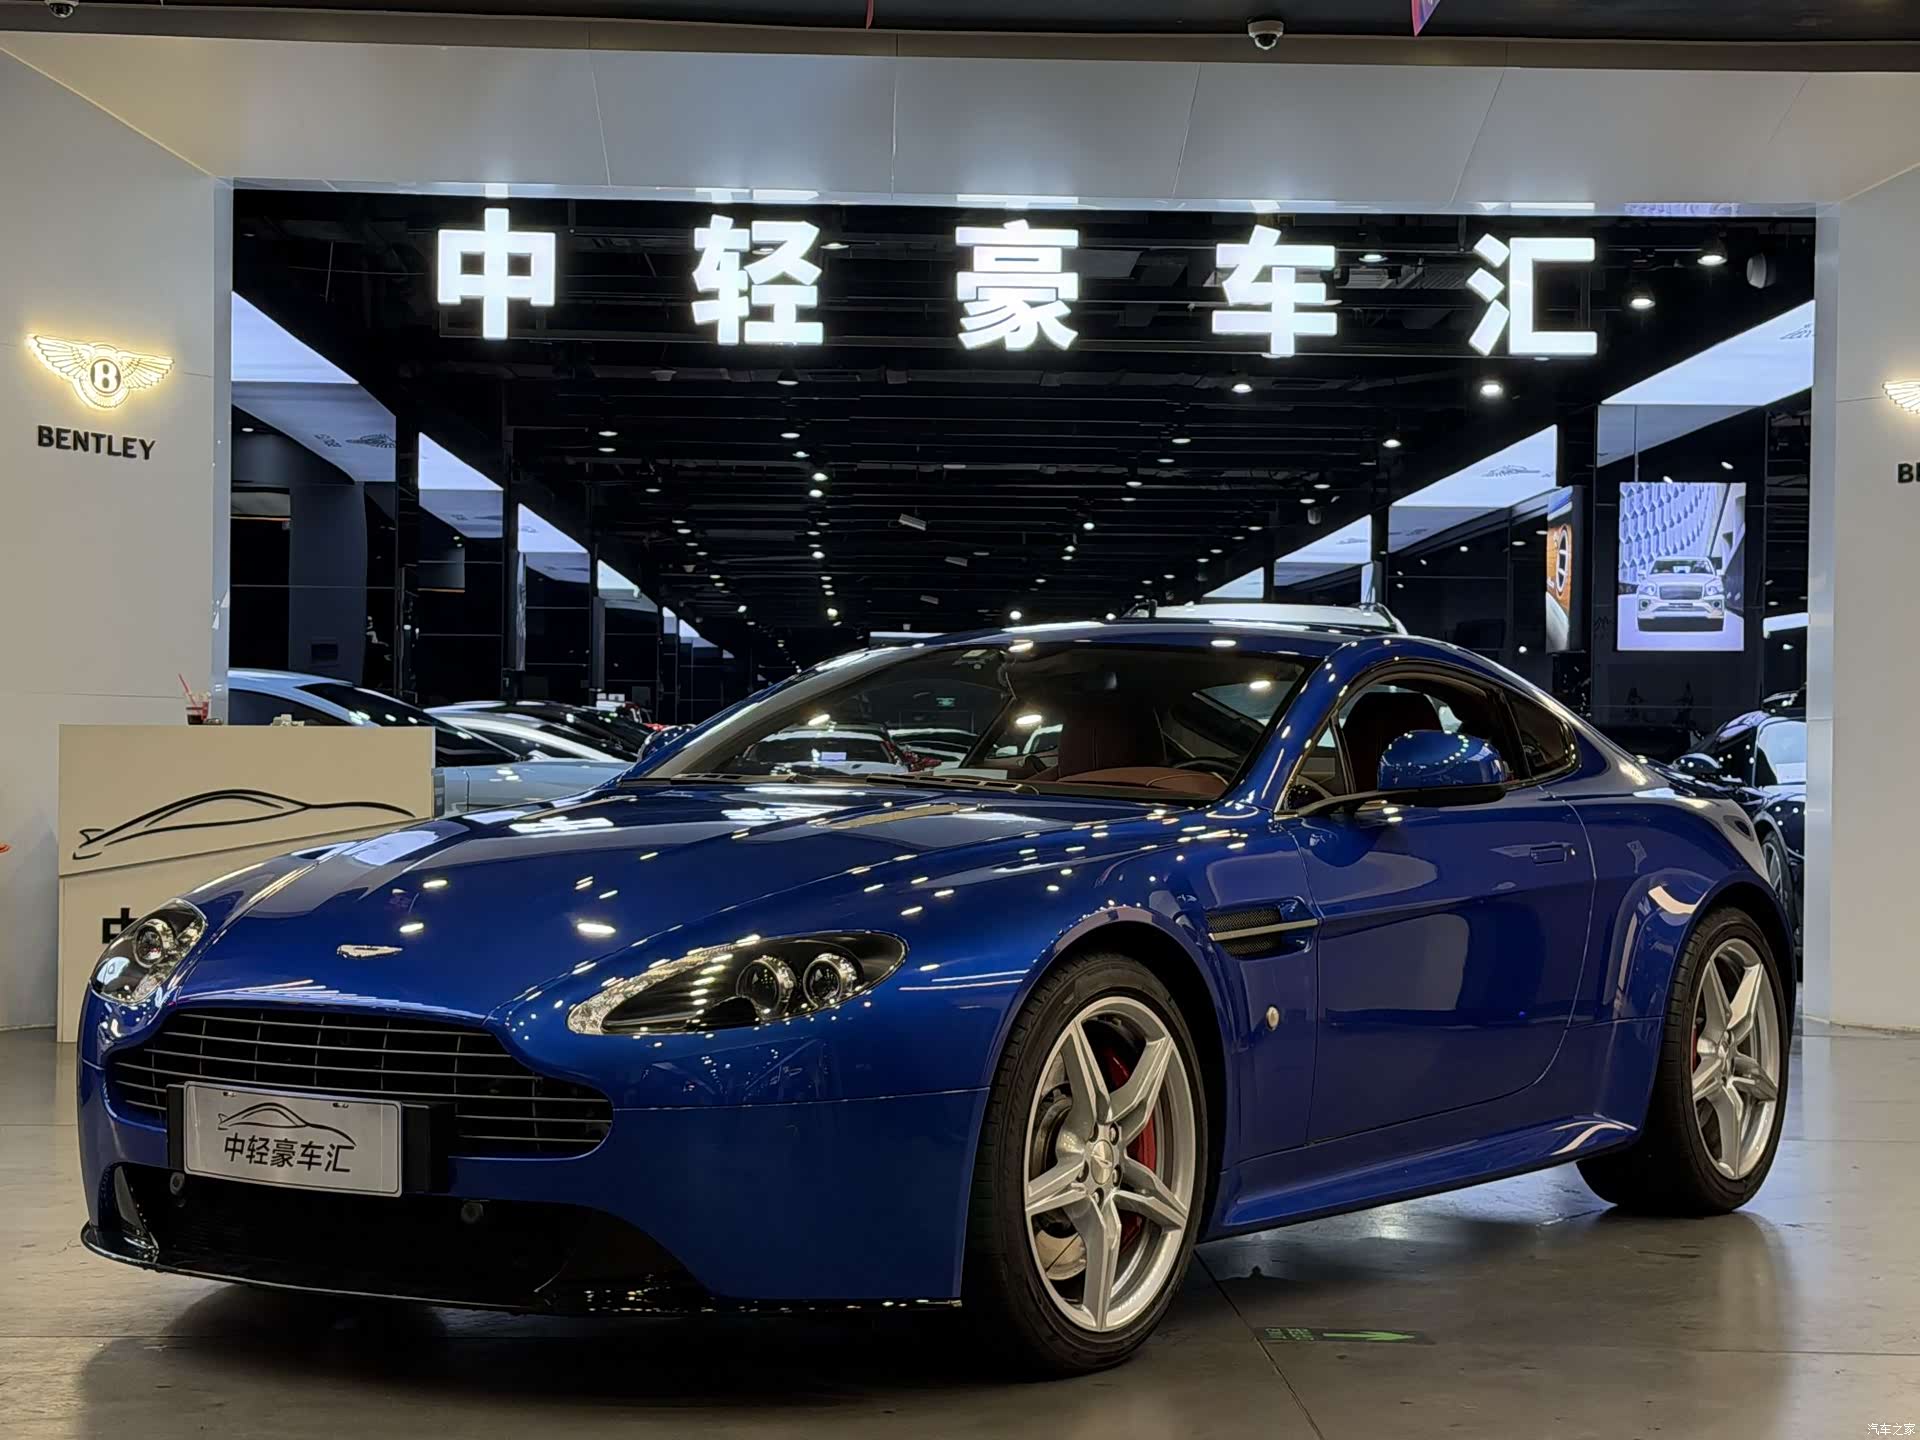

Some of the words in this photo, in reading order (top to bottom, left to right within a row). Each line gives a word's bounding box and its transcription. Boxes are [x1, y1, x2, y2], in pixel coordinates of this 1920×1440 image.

[437, 207, 1598, 357] 中轻豪车汇
[37, 424, 156, 461] BENTLEY
[224, 1132, 355, 1173] 中轻豪车汇
